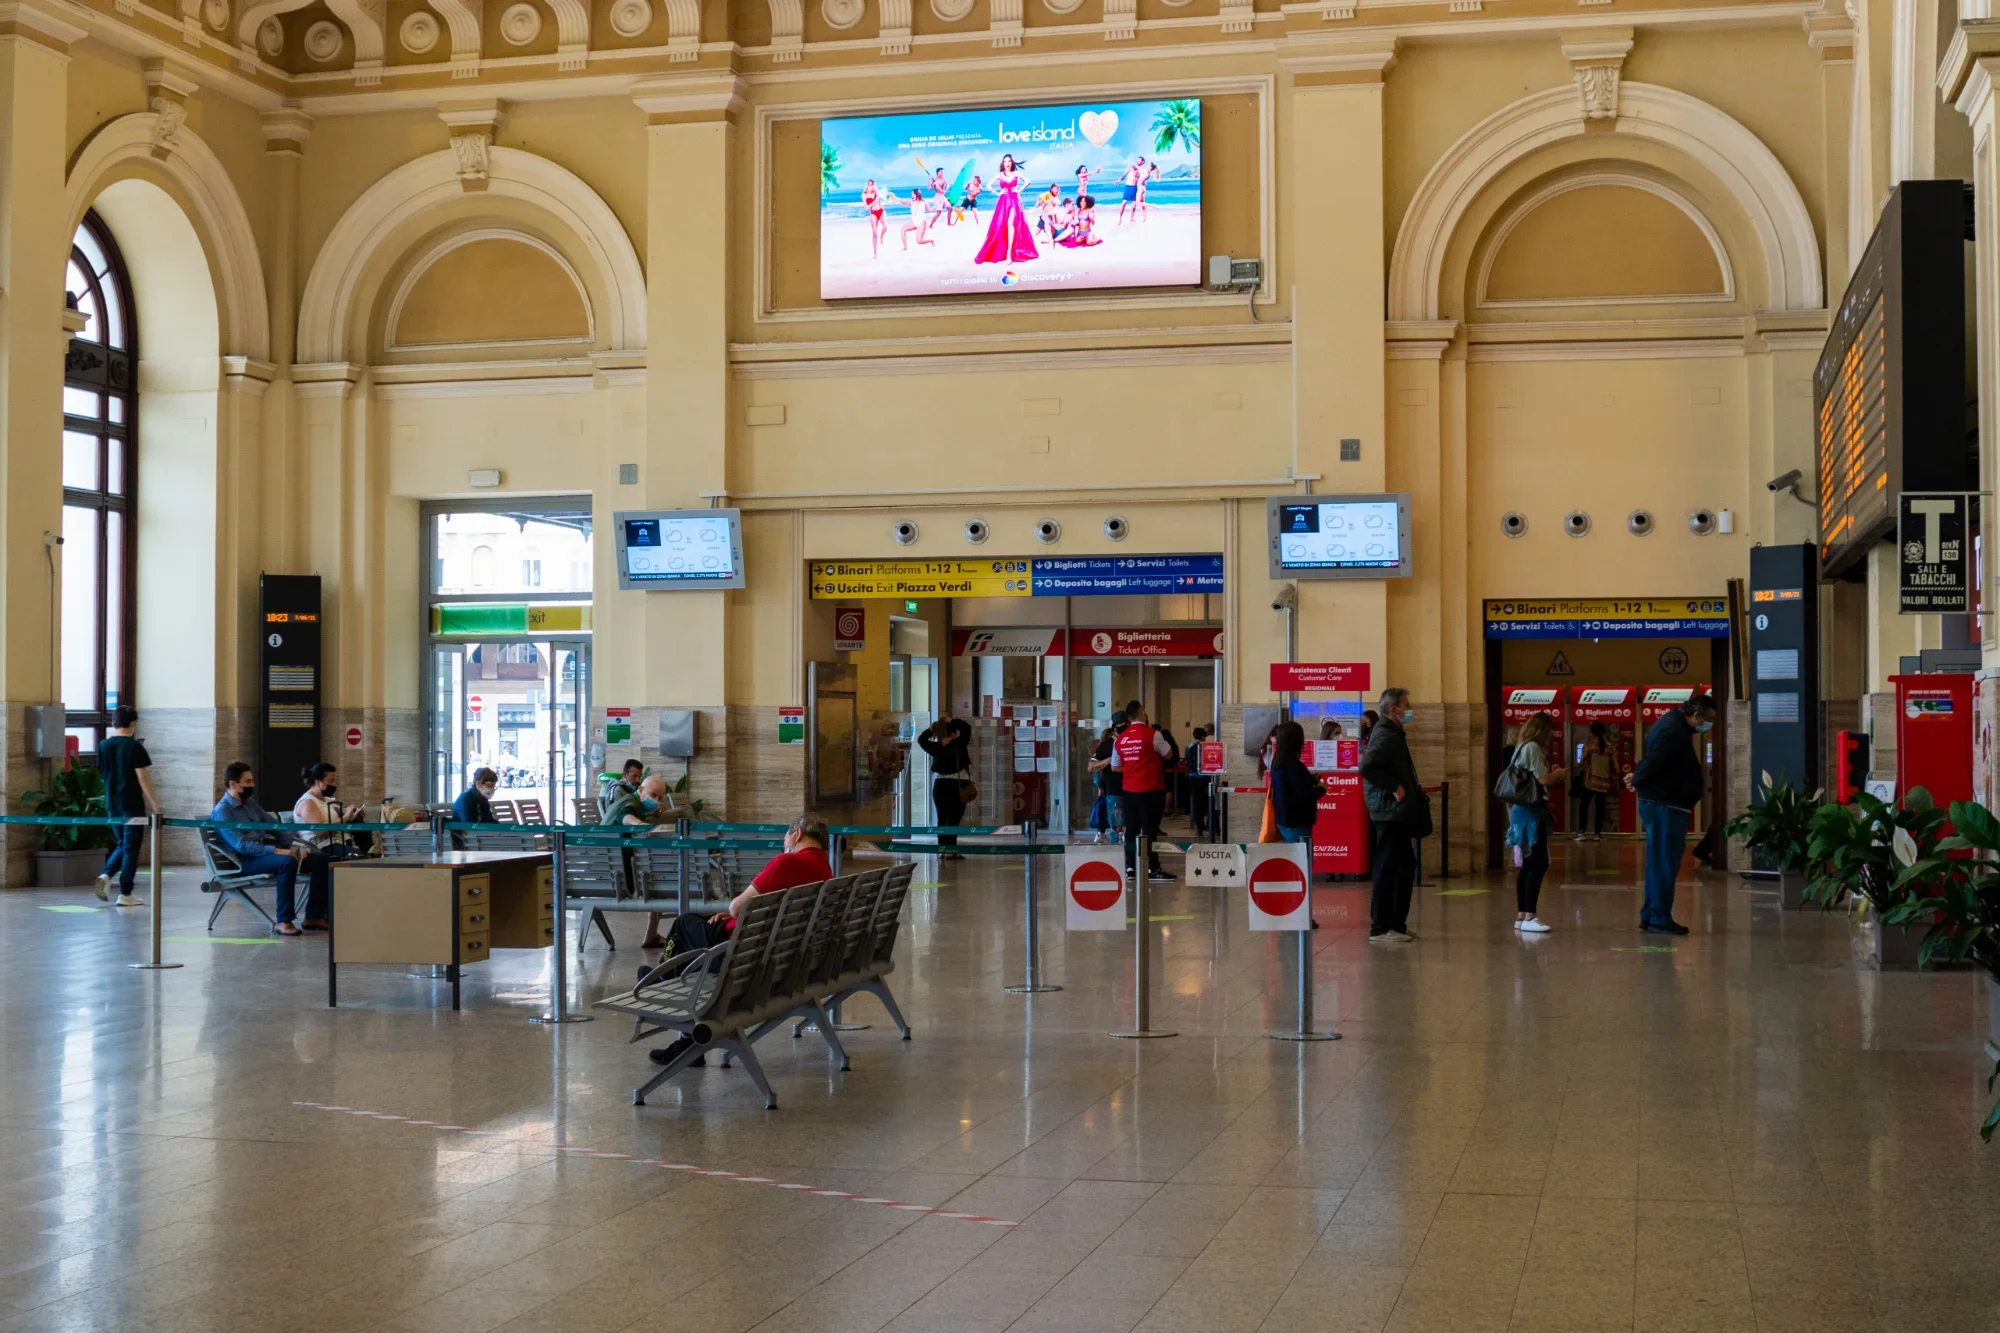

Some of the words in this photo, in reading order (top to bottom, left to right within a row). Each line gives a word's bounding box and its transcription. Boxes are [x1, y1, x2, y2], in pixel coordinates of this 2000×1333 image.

[999, 122, 1030, 143] love
[1032, 119, 1074, 141] island
[1021, 272, 1073, 282] discovery+
[1911, 500, 1955, 563] T
[1054, 560, 1086, 569] Biglietti
[1137, 559, 1166, 567] Servizi
[838, 565, 873, 575] Binari
[877, 564, 921, 574] Platforms
[925, 564, 951, 573] 1-12
[956, 564, 961, 573] 1
[1918, 565, 1937, 573] SALI
[1942, 565, 1947, 573] E
[1054, 579, 1091, 588] Deposito
[1094, 578, 1127, 588] bagagli
[1128, 578, 1141, 586] Left
[1143, 578, 1171, 588] luggage
[1910, 574, 1956, 585] TABACCHI
[838, 582, 873, 593] Uscita
[876, 582, 893, 593] Exit
[896, 582, 936, 593] Piazza
[939, 581, 972, 592] Verdi
[1902, 596, 1928, 605] VALORI
[1933, 596, 1964, 604] BOLLATI
[1518, 604, 1556, 614] Binari
[1560, 603, 1609, 614] Platforms
[1613, 603, 1641, 613] 1-12
[1648, 603, 1653, 612] 1
[1511, 622, 1541, 630] Servizi
[1543, 622, 1565, 630] Toilets
[1603, 621, 1643, 631] Deposito
[1646, 621, 1680, 631] bagagli
[1683, 621, 1696, 629] Left
[1698, 621, 1729, 631] luggage
[1118, 632, 1171, 642] Biglietteria
[990, 645, 1042, 653] TRENITALIA
[1118, 645, 1140, 654] Ticket
[1142, 645, 1167, 654] Office
[1327, 777, 1358, 785] Clienti
[1199, 851, 1231, 859] USCITA
